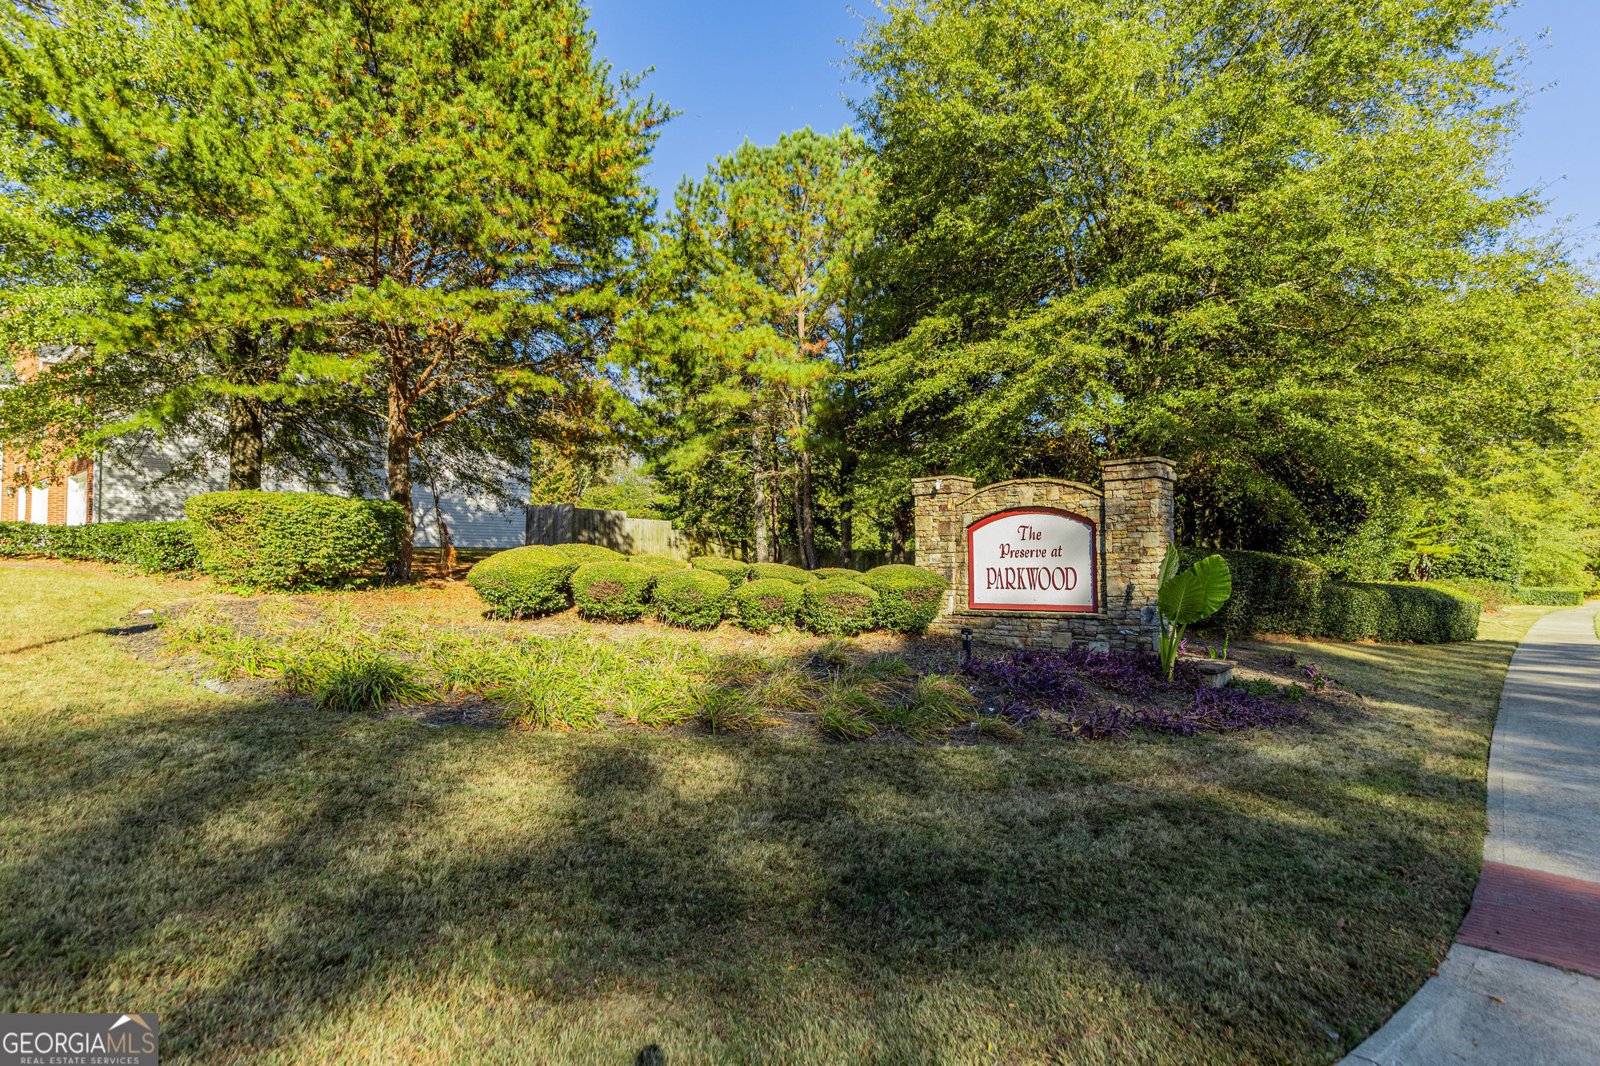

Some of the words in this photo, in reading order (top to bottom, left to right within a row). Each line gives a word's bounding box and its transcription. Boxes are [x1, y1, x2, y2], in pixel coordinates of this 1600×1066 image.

[1017, 525, 1042, 541] The
[999, 543, 1047, 559] Preserve
[1051, 545, 1063, 558] at
[986, 566, 1078, 591] PARKWOOD
